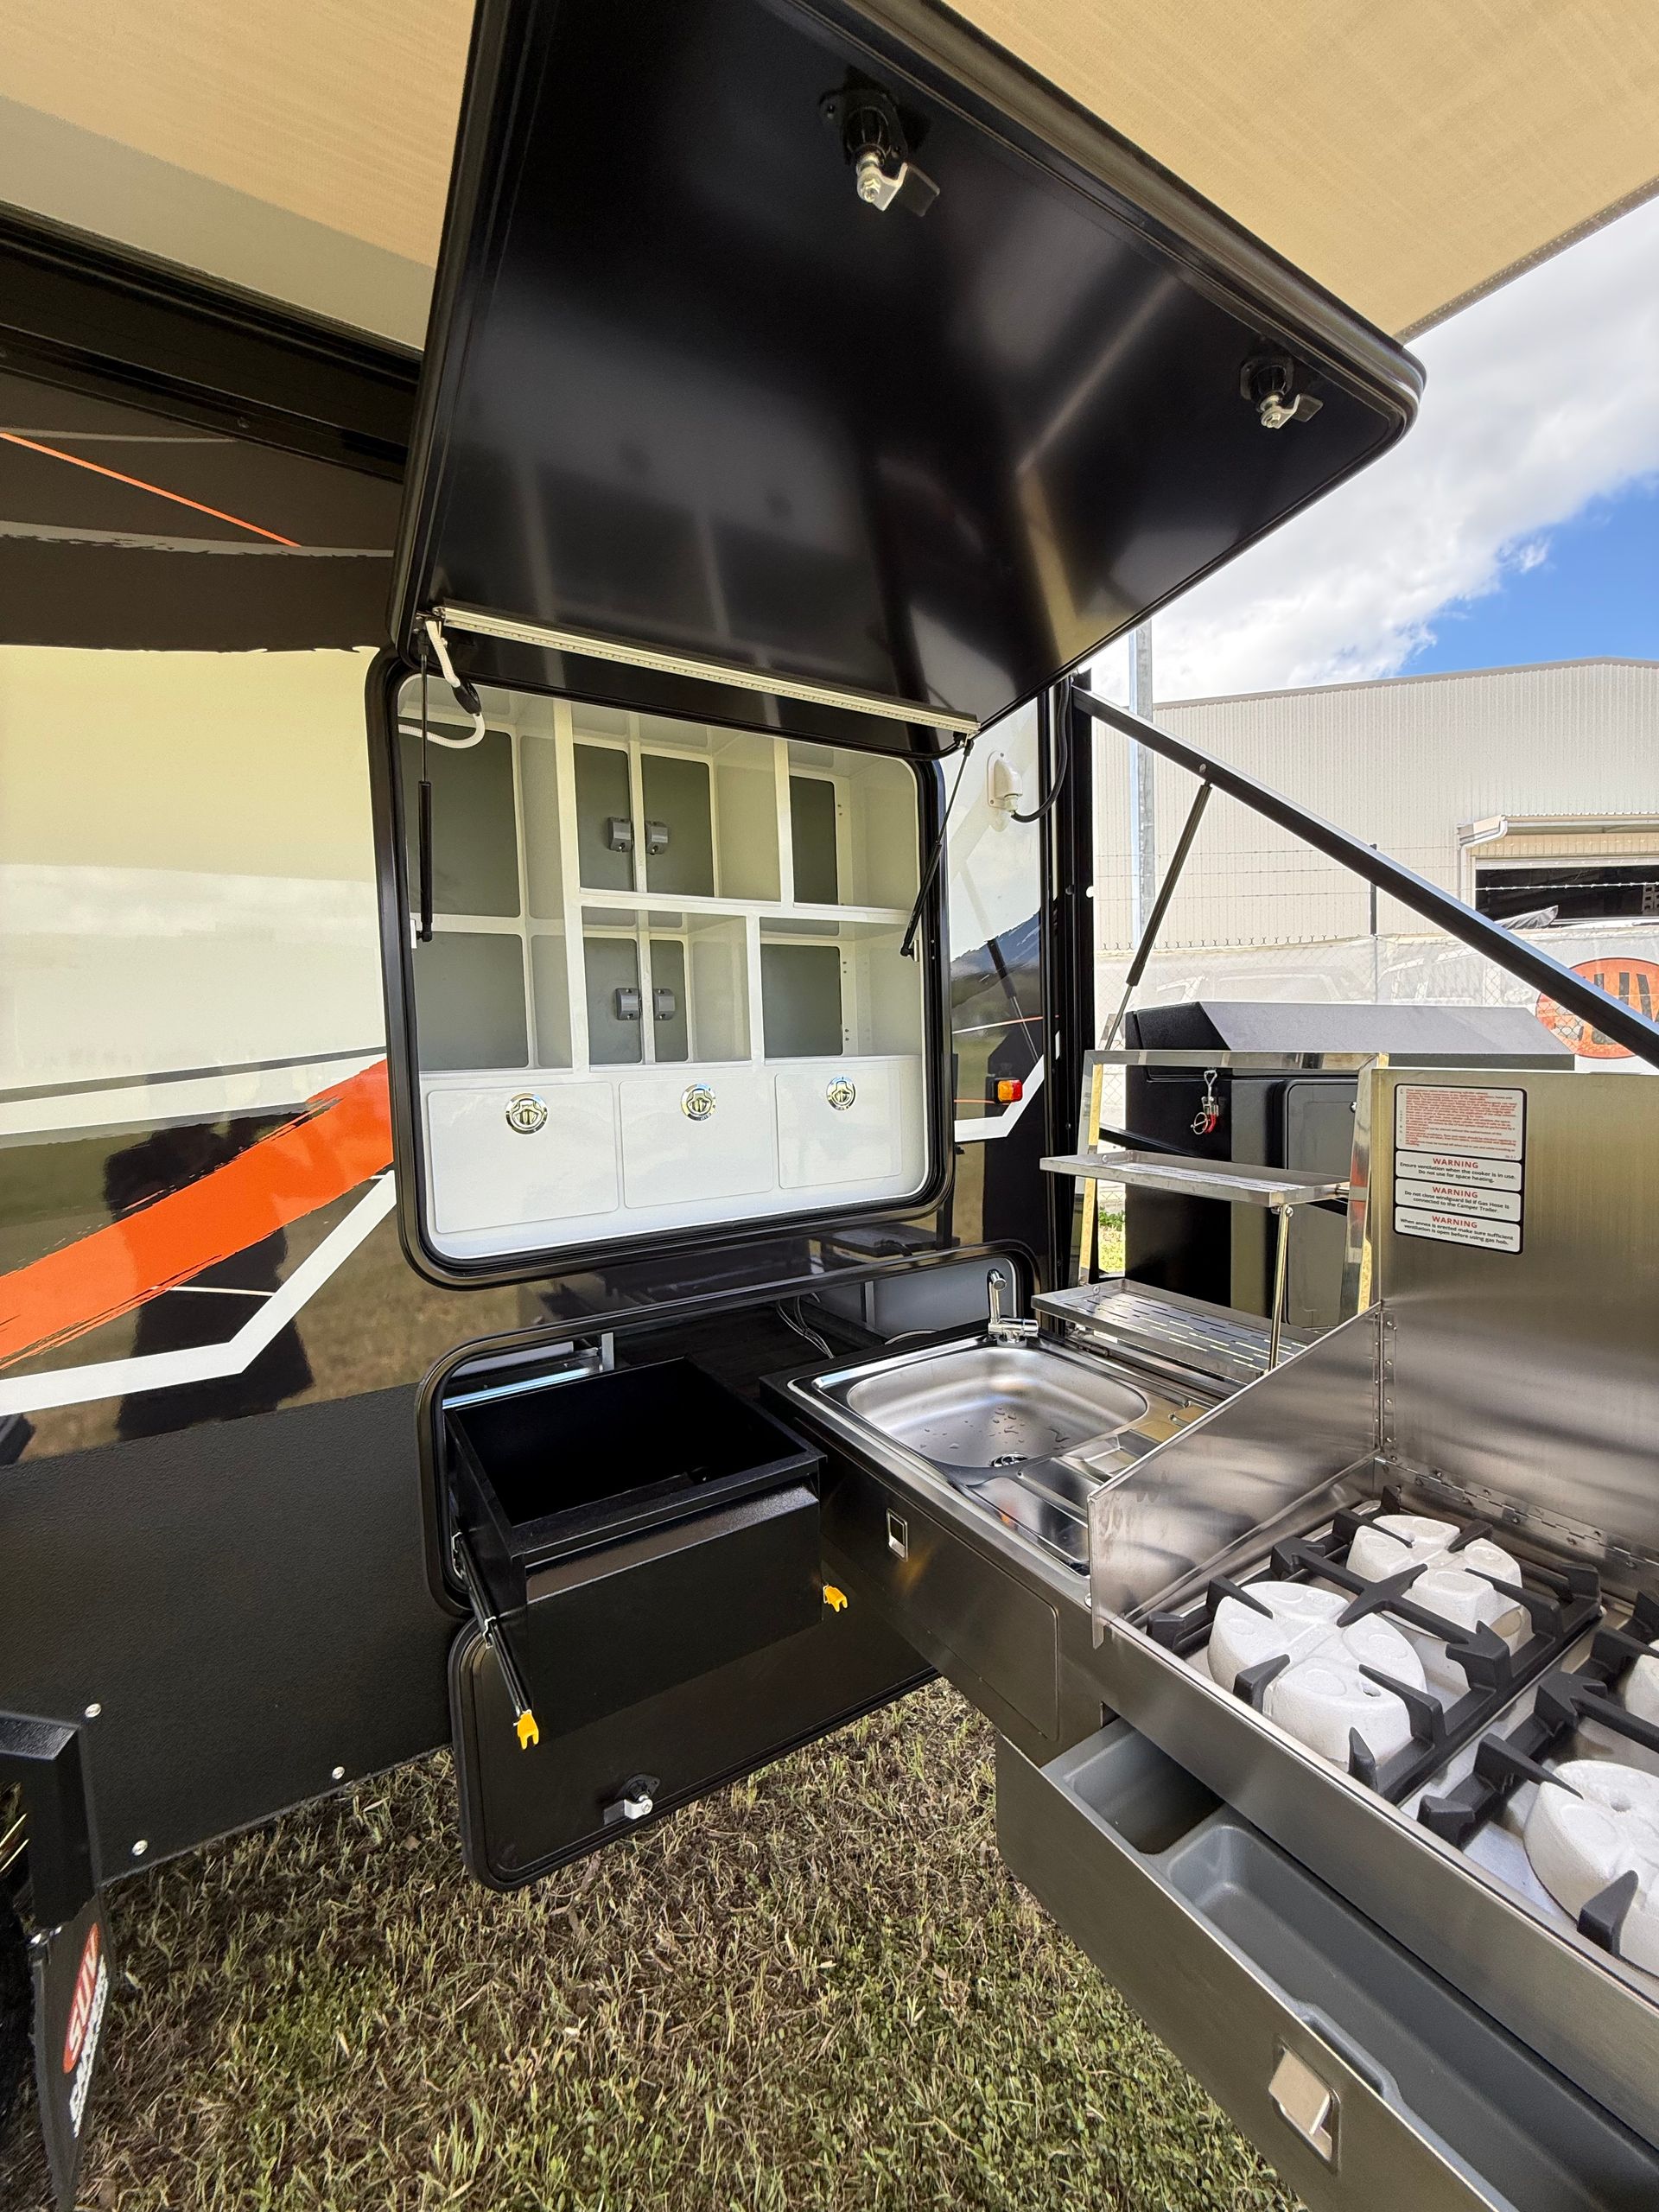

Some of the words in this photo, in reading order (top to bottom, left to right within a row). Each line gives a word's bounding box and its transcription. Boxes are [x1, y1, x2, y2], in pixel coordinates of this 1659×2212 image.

[1433, 1158, 1479, 1168] WARNING
[1432, 1186, 1478, 1198] WARNING
[1432, 1216, 1477, 1228] WARNING
[1487, 1232, 1514, 1240] sufficient
